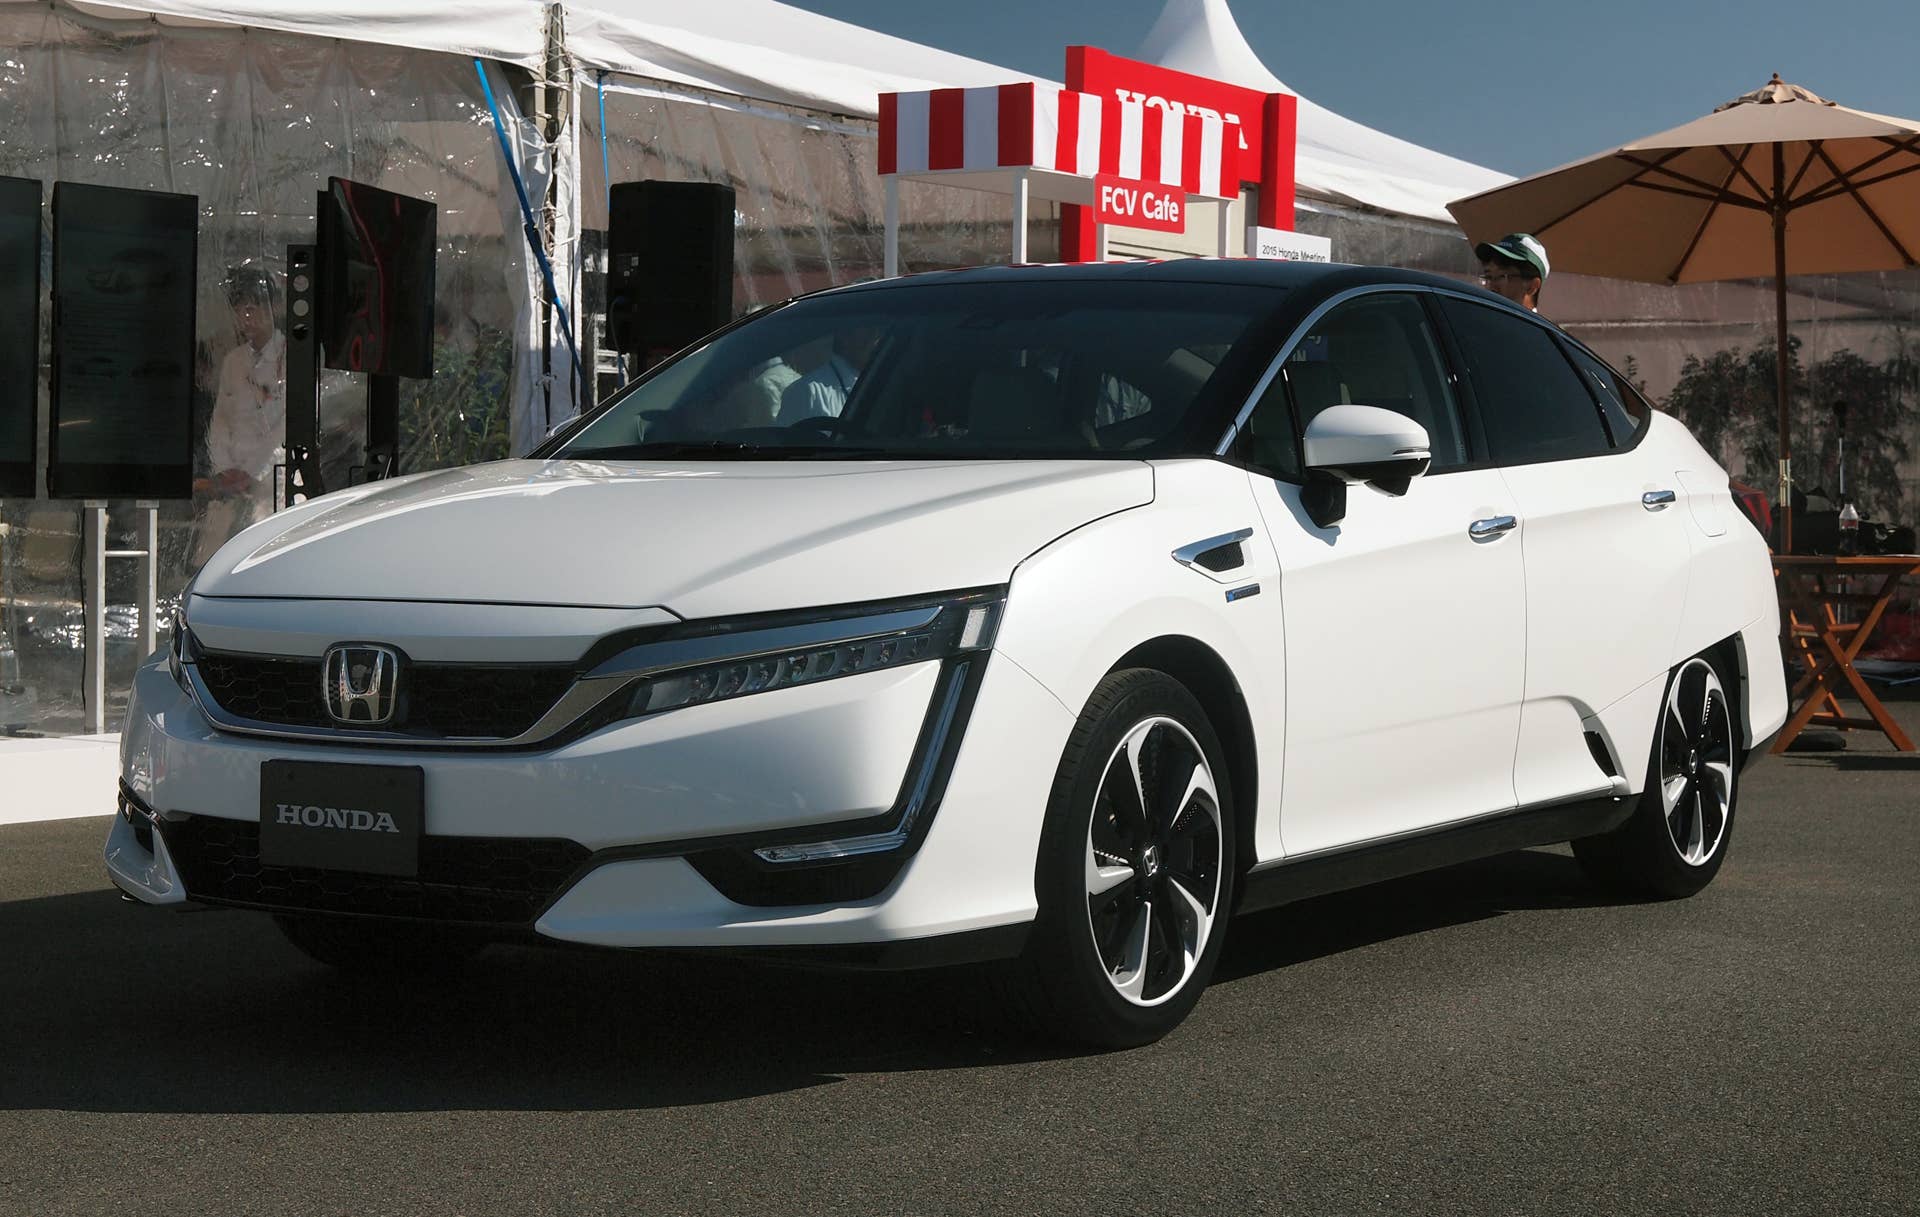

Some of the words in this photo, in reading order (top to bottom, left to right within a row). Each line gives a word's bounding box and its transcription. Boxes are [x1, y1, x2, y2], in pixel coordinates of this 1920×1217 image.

[1102, 185, 1138, 216] FCV
[1142, 192, 1179, 222] Cafe
[1262, 244, 1278, 256] 2015
[1279, 247, 1299, 260] Honda
[276, 804, 400, 833] HONDA
